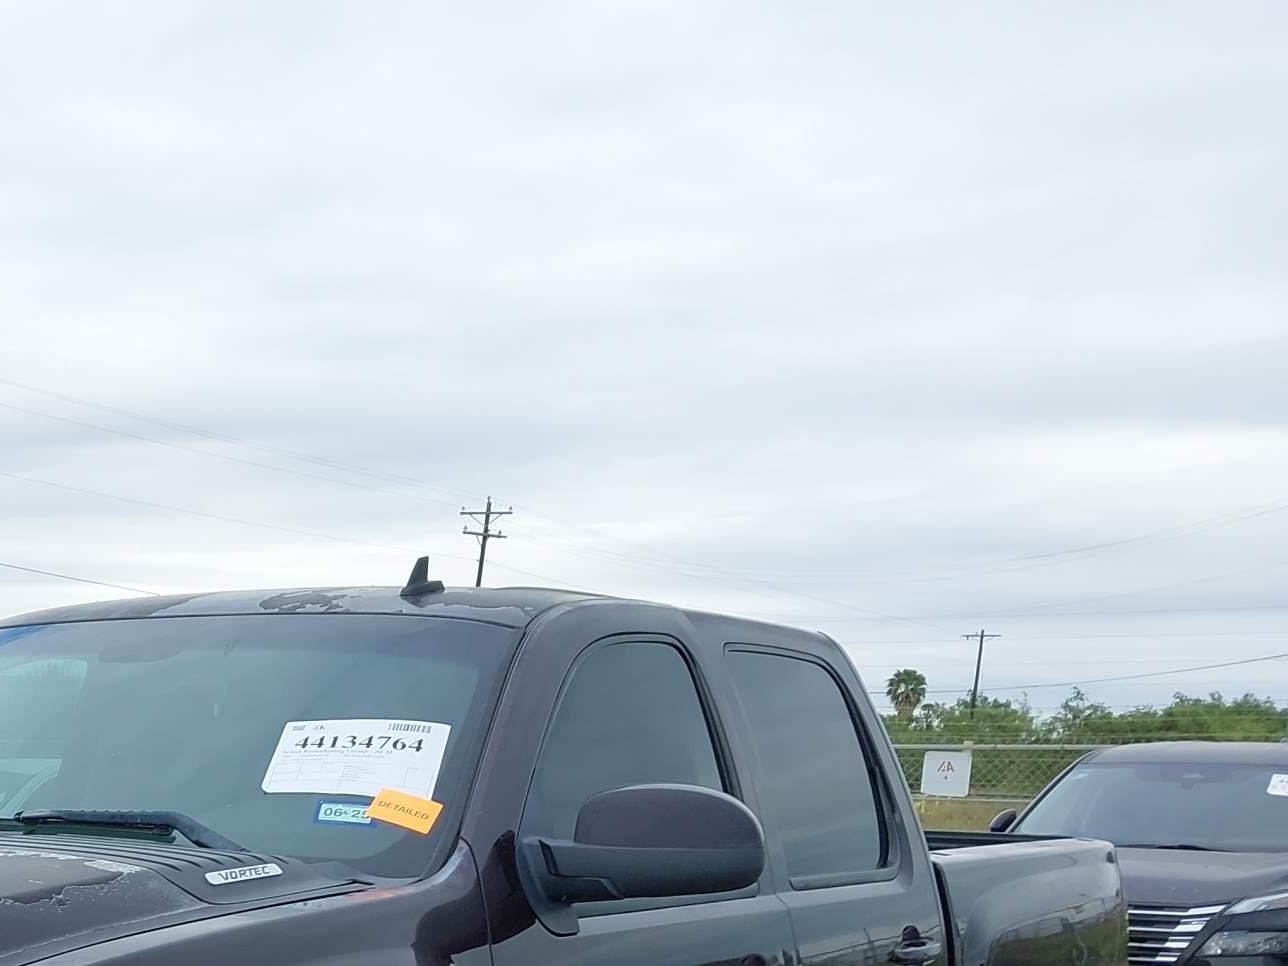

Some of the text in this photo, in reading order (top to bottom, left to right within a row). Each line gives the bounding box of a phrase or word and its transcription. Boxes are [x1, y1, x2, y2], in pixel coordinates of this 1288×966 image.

[294, 735, 424, 753] 44134764
[378, 799, 430, 821] DETAILED
[218, 865, 270, 881] VORTEC
